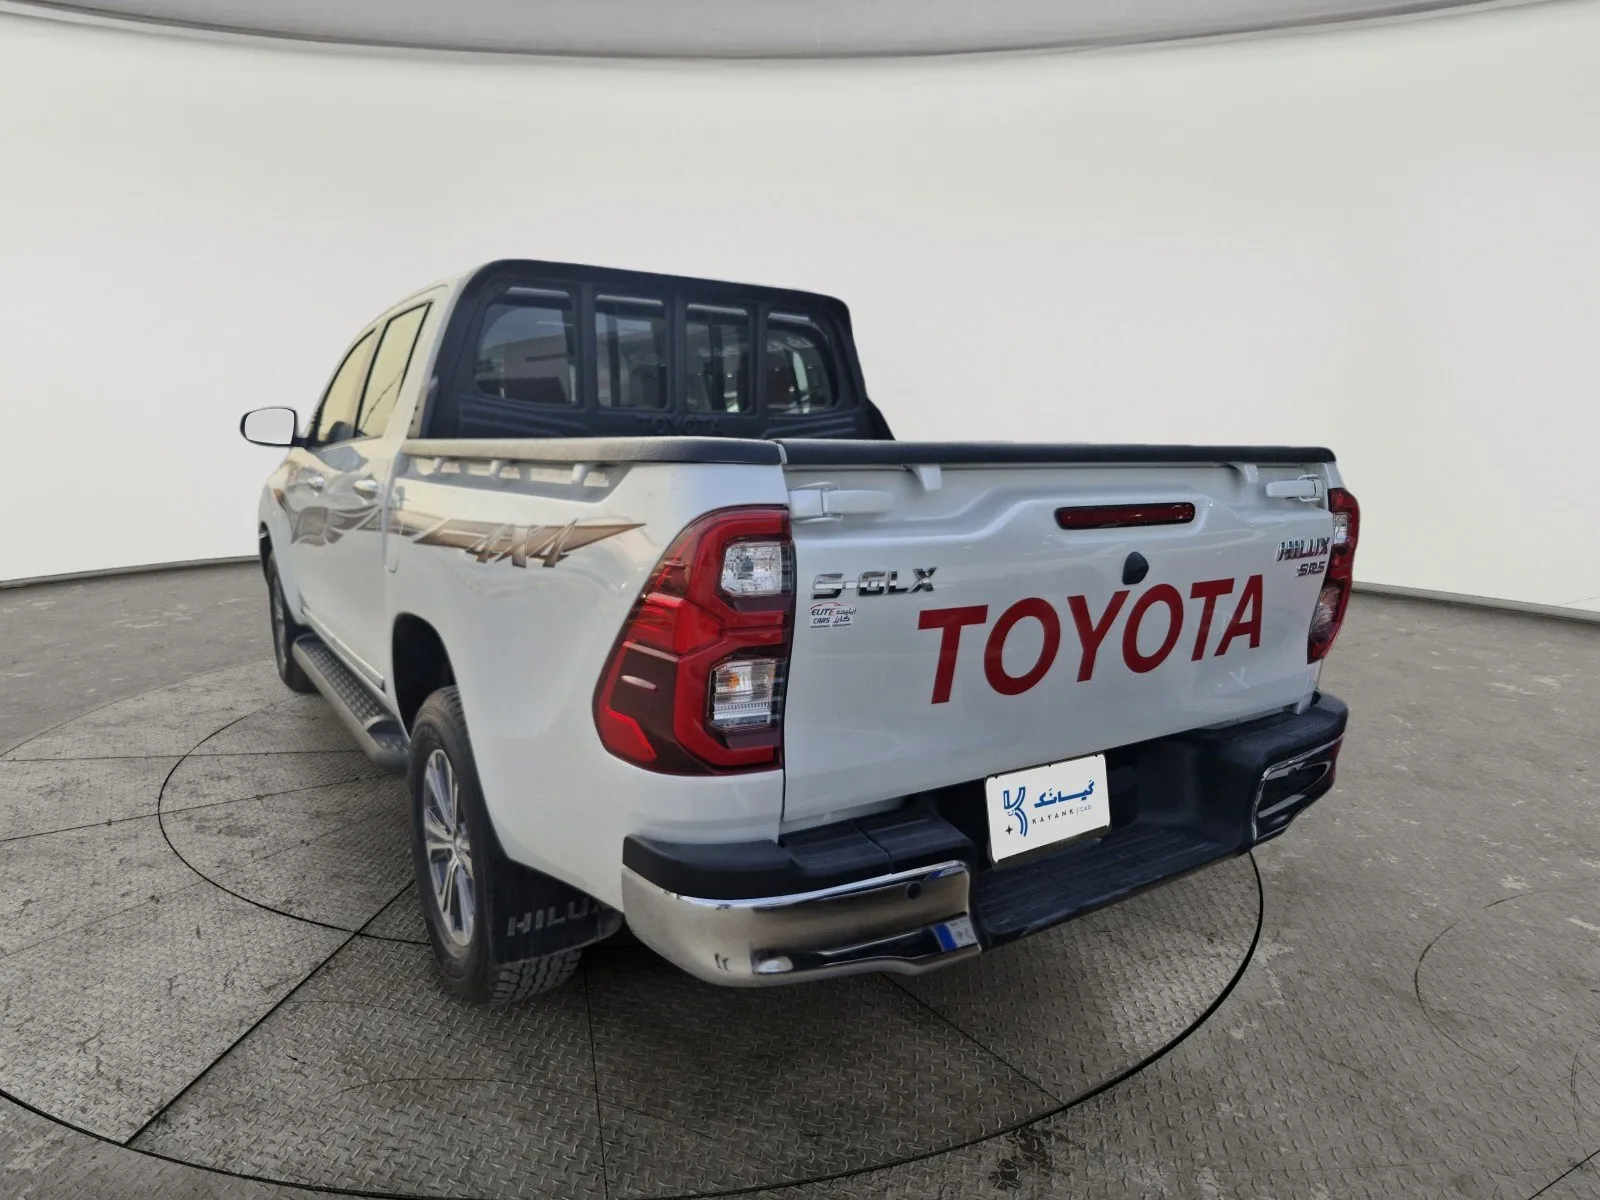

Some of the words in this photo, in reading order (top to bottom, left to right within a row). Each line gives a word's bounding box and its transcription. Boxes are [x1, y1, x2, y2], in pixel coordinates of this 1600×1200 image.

[1274, 537, 1330, 561] HILUX
[811, 566, 937, 600] S-GLX
[811, 608, 836, 616] ELITE
[917, 574, 1263, 704] TOYOTA
[1032, 809, 1074, 824] KAYANK
[1080, 804, 1092, 812] CAR
